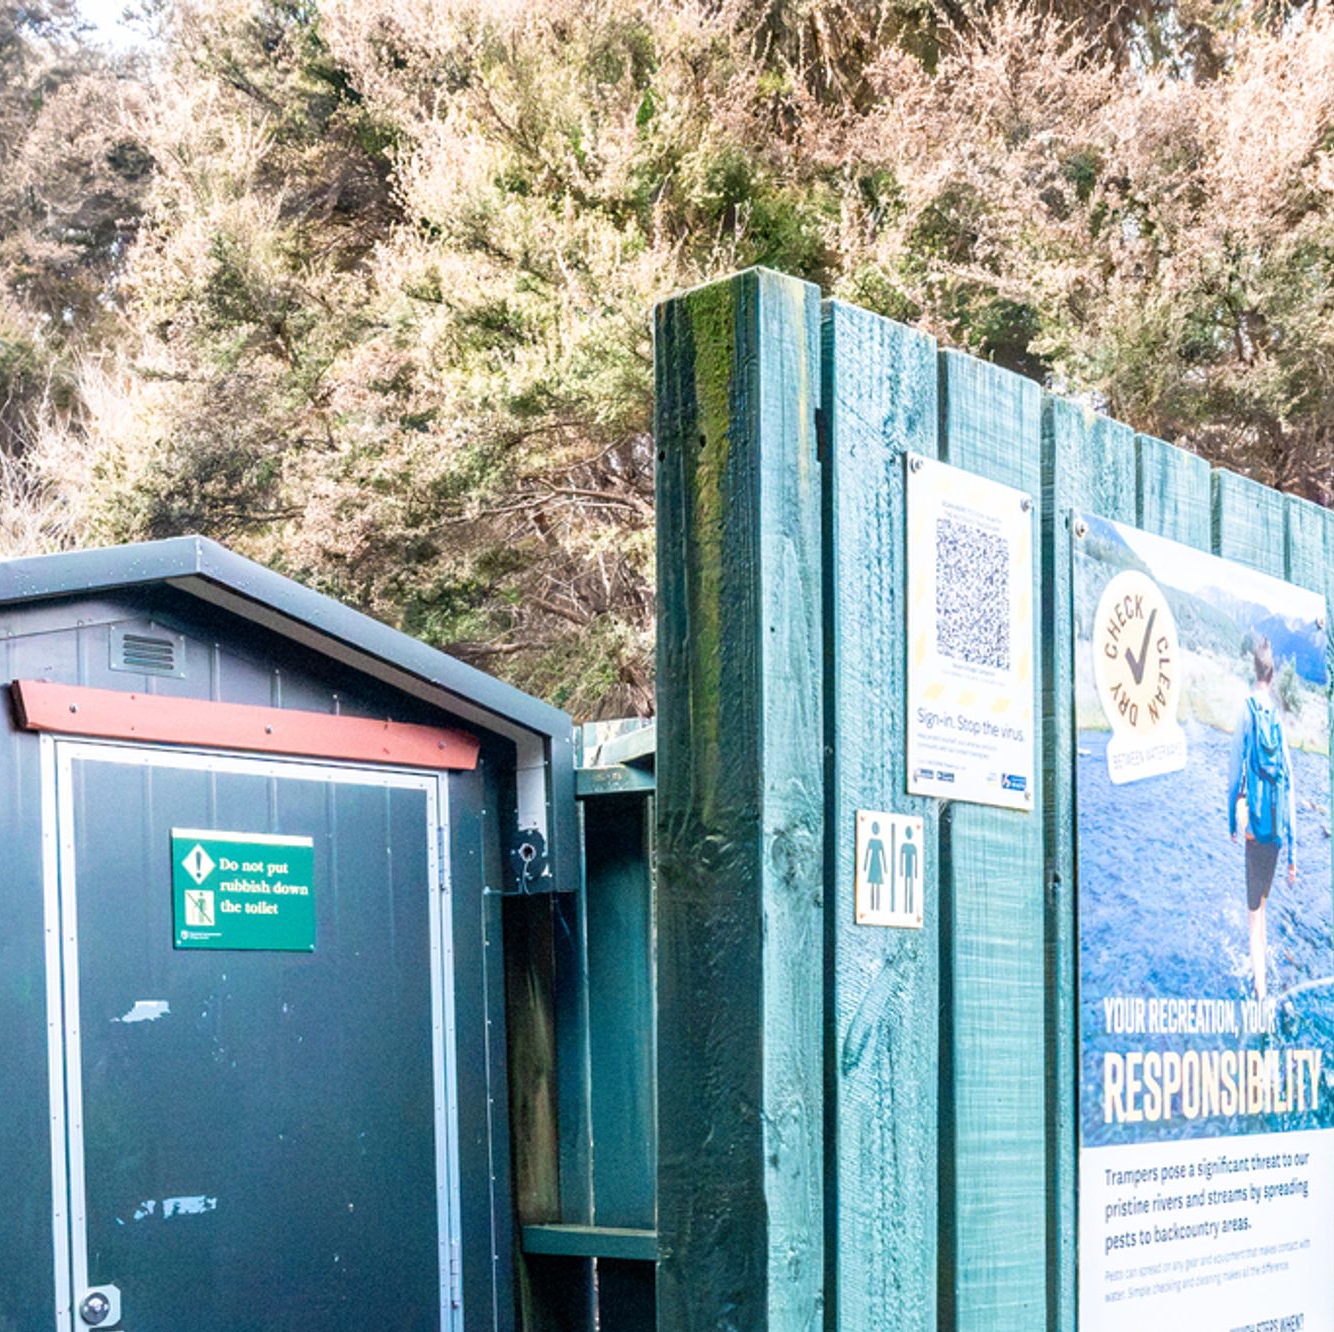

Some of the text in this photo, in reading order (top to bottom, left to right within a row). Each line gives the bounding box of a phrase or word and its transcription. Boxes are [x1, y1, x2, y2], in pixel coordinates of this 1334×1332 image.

[1104, 594, 1143, 659] CHECK
[1148, 636, 1171, 725] CLEAN
[917, 707, 1026, 742] Sign-in. Stop the virus.
[1110, 682, 1139, 727] DRY
[219, 858, 288, 877] Do not put
[220, 879, 309, 895] rubbish down
[220, 899, 278, 914] the toilet
[1103, 997, 1277, 1038] YOUR RECREATION, YOUR
[1103, 1050, 1322, 1124] RESPONSIBILITY
[1105, 1152, 1310, 1187] Trampers pose a significant threat to our
[1105, 1177, 1309, 1223] pristine rivers and streams by spreading
[1105, 1215, 1252, 1255] pests to backcountry areas.
